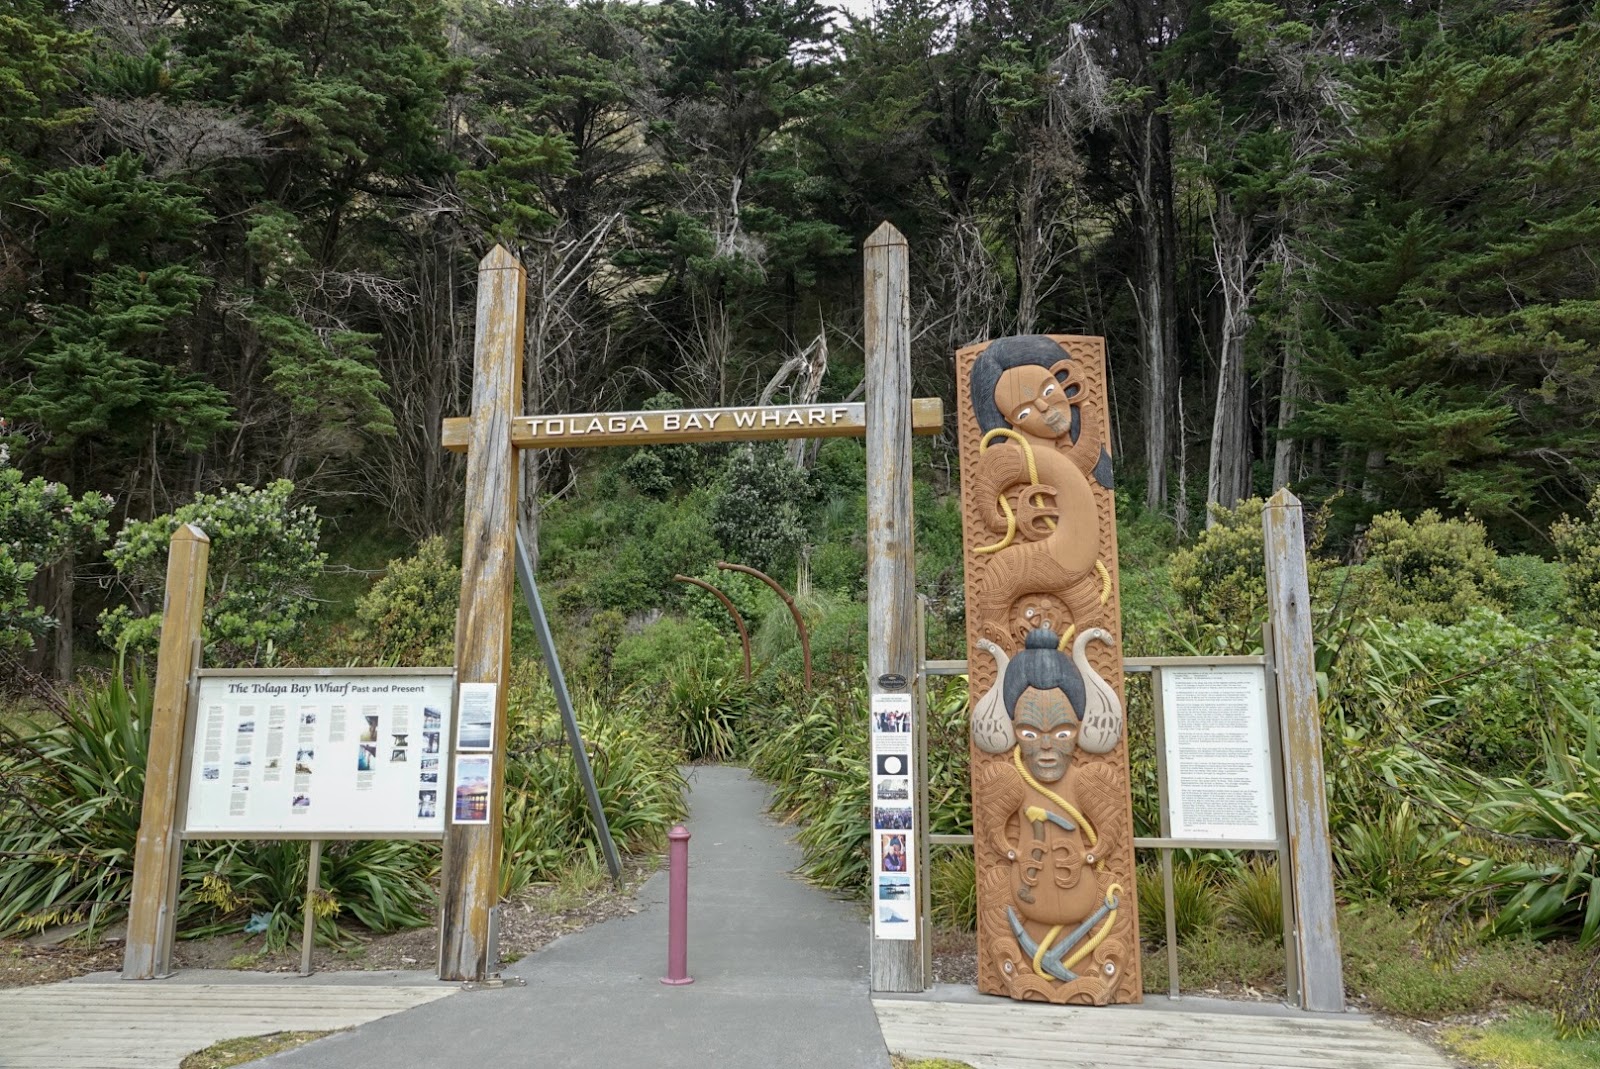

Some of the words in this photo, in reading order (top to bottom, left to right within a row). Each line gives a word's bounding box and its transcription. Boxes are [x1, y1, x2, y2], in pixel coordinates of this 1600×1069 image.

[527, 415, 648, 435] TOLAGA
[664, 413, 720, 430] BAY
[733, 408, 847, 427] WHARF
[228, 682, 249, 693] The
[251, 682, 287, 697] Tolaga
[290, 683, 311, 697] Bay
[314, 682, 351, 697] Wharf
[352, 685, 370, 693] Past
[371, 685, 389, 693] and
[391, 685, 425, 693] Present
